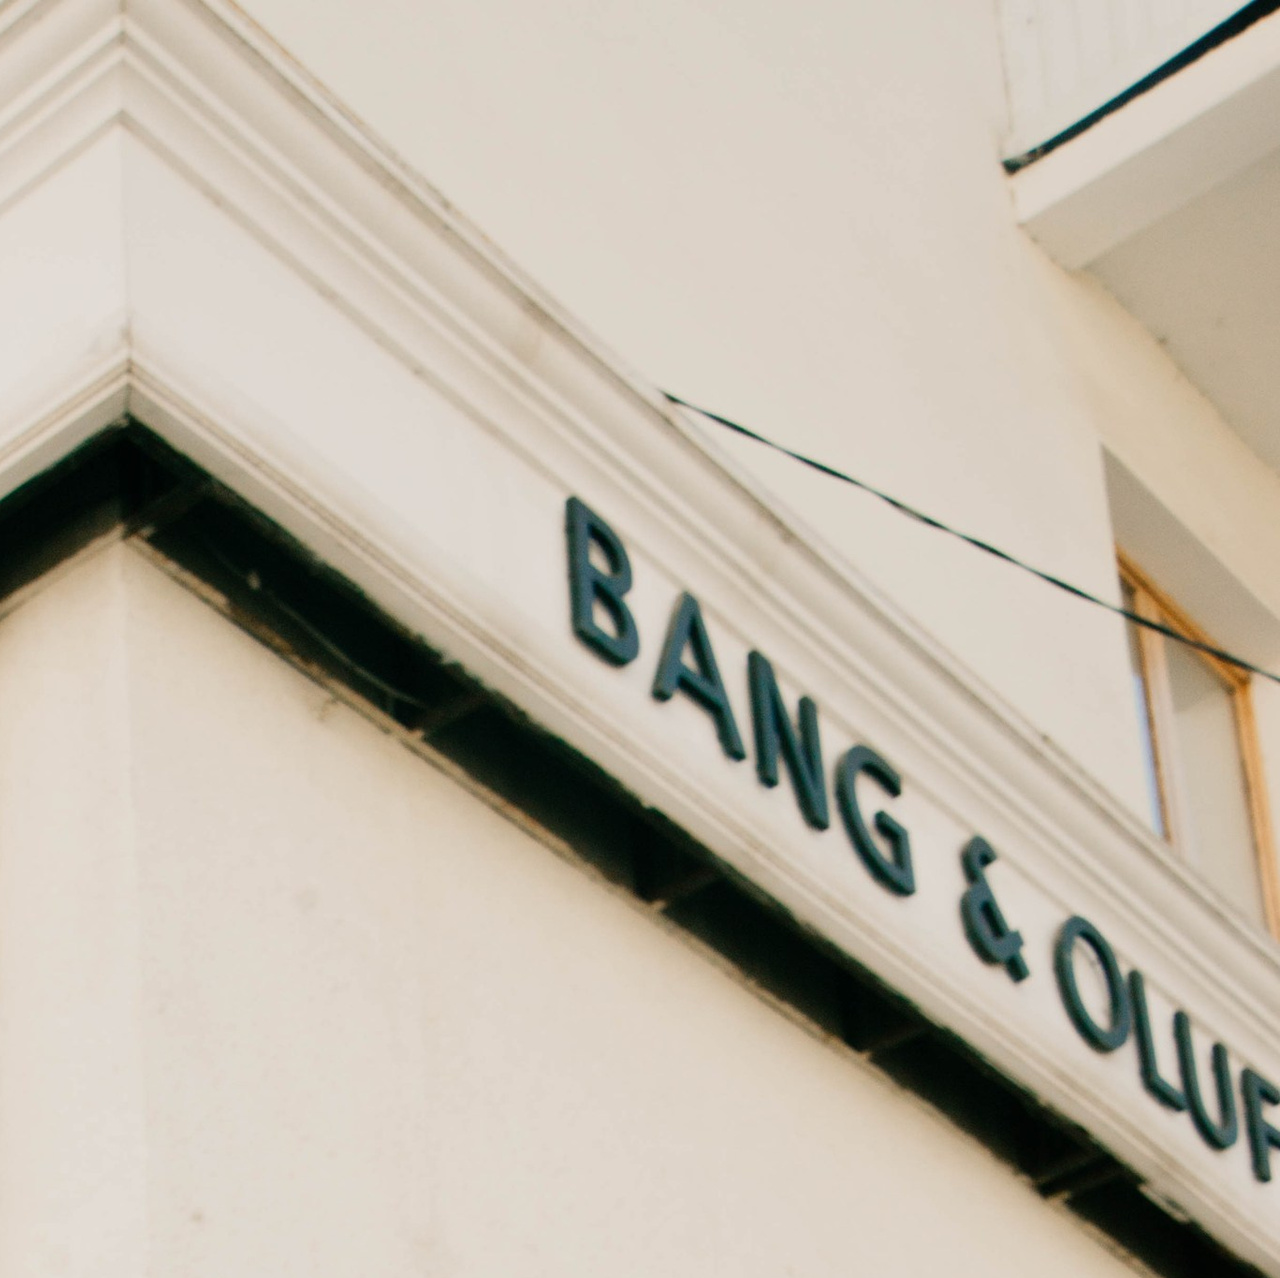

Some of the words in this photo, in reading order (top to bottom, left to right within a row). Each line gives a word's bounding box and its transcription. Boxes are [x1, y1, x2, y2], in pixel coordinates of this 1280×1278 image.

[564, 495, 916, 896] BANG
[959, 836, 1030, 982] &
[1054, 915, 1280, 1182] OLUF
